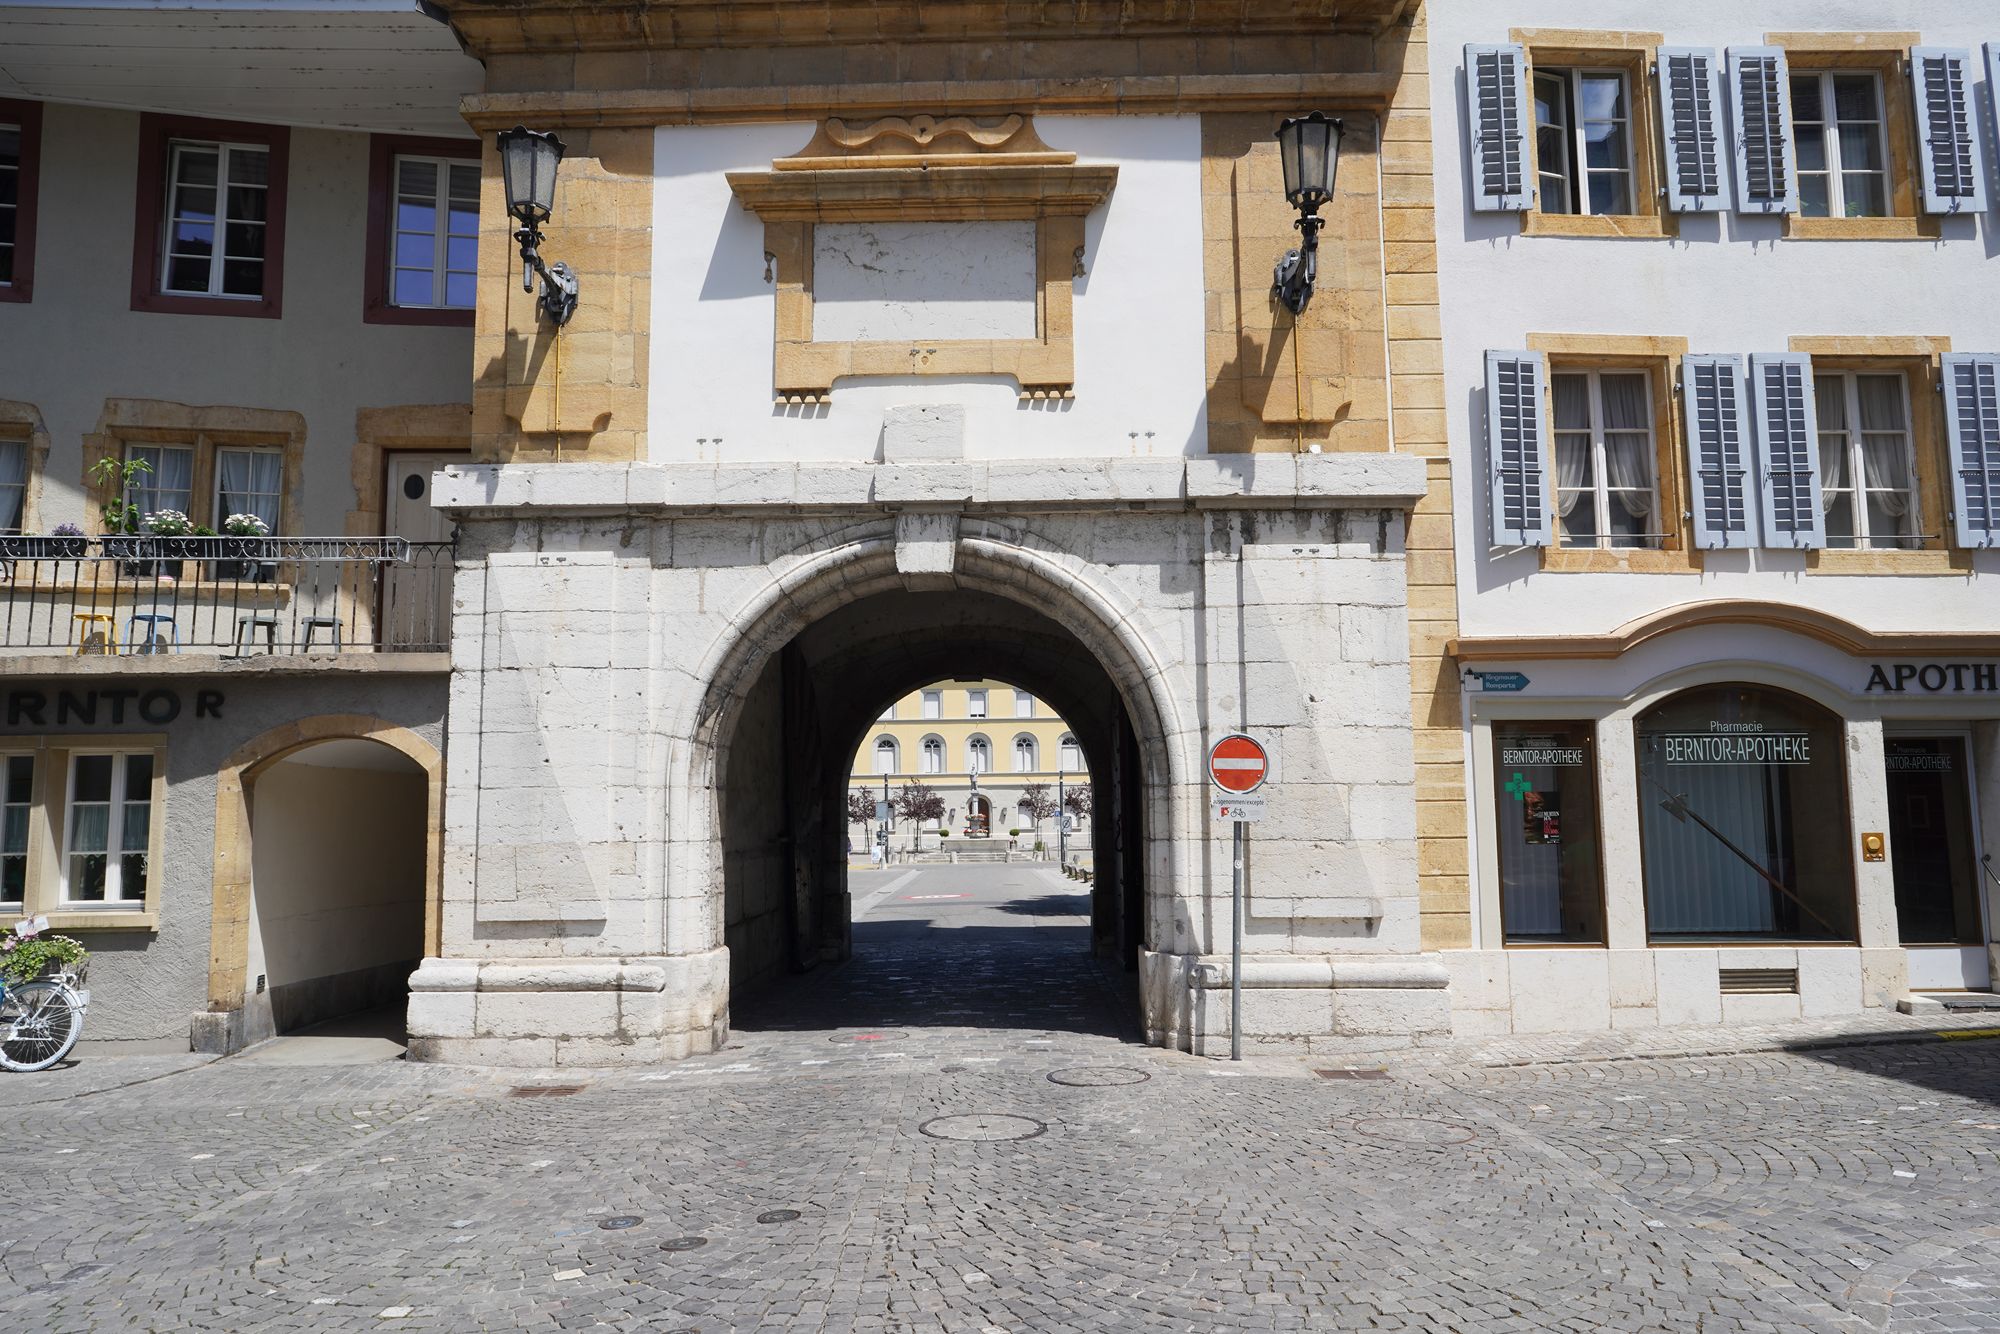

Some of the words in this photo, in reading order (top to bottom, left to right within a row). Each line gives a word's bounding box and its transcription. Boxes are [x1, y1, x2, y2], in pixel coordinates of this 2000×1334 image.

[1864, 664, 1999, 691] APOTH
[1710, 720, 1763, 732] Pharmacie
[1503, 750, 1583, 763] BERNTOR-APOTHEKE
[1666, 737, 1810, 761] BERNTOR-APOTHEKE
